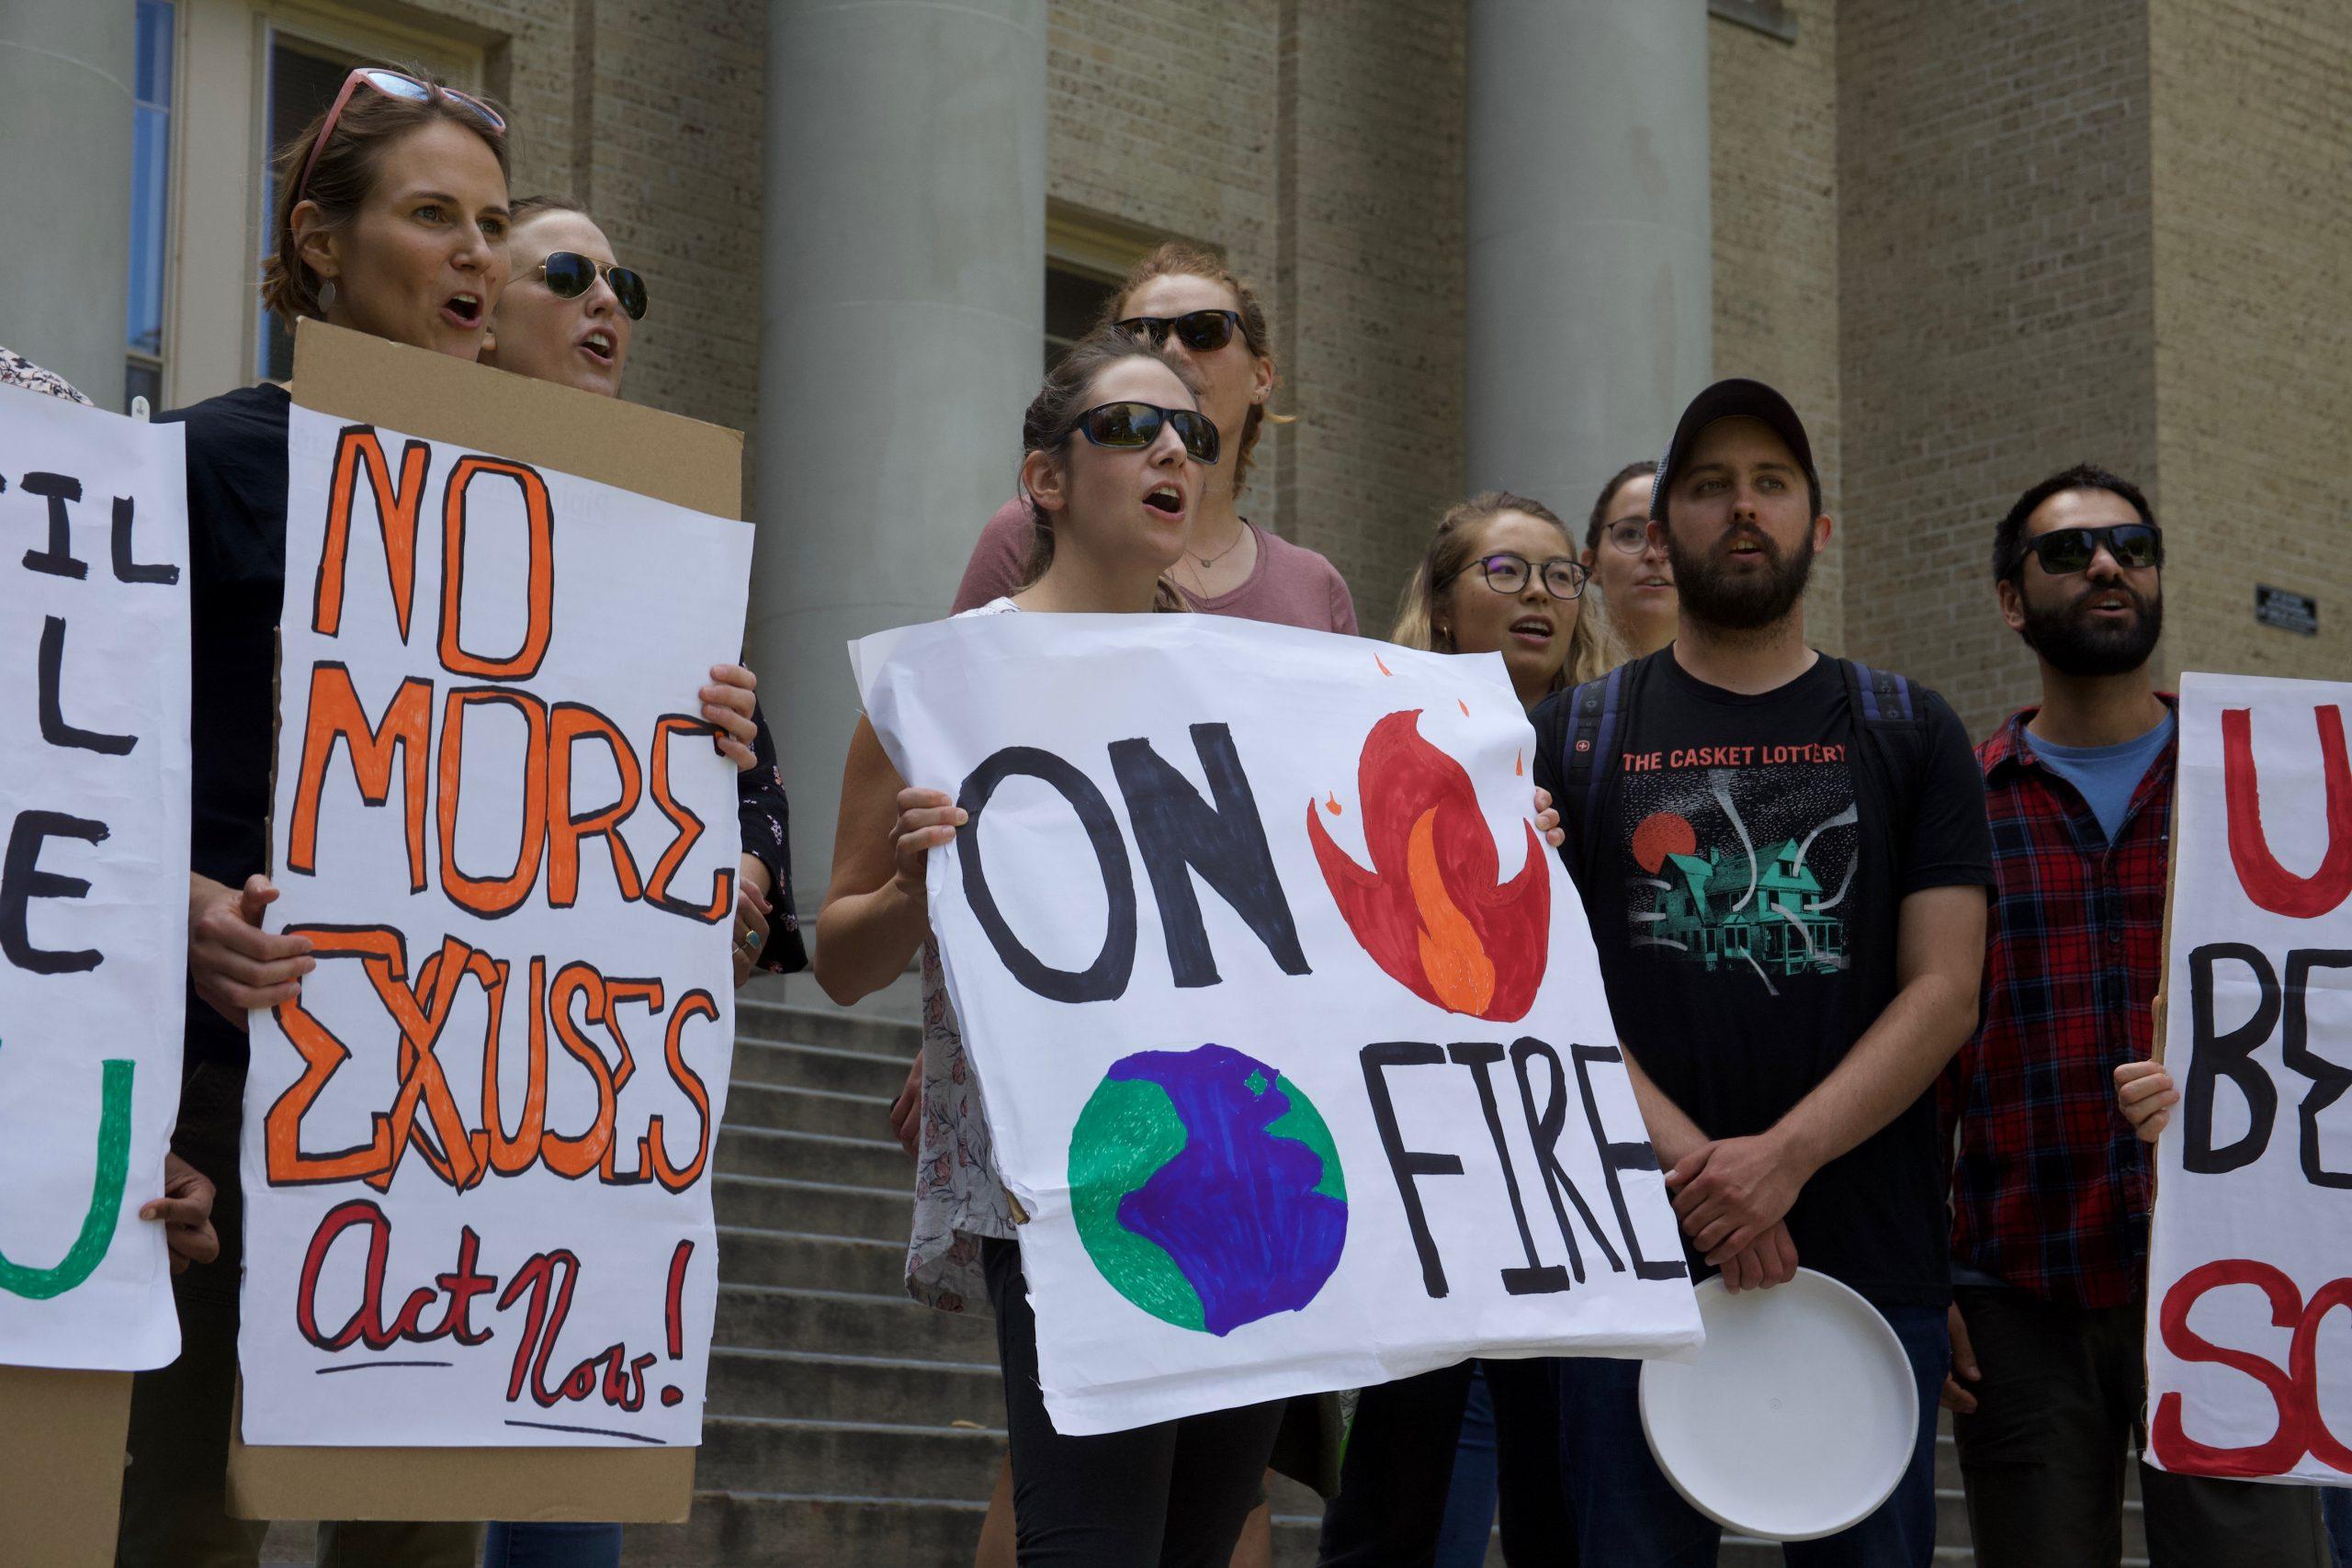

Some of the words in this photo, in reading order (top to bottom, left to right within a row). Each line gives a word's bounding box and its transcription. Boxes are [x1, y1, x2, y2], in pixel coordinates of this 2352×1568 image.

[312, 424, 555, 682] NO
[288, 660, 735, 920] MORE
[957, 723, 1312, 1004] ON
[1623, 751, 1663, 773] THE
[1670, 746, 1755, 768] CASKET
[1762, 743, 1847, 765] LOTTERY
[1360, 1036, 1687, 1299] FIRE
[297, 1199, 498, 1353] Act
[497, 1240, 695, 1413] Now!
